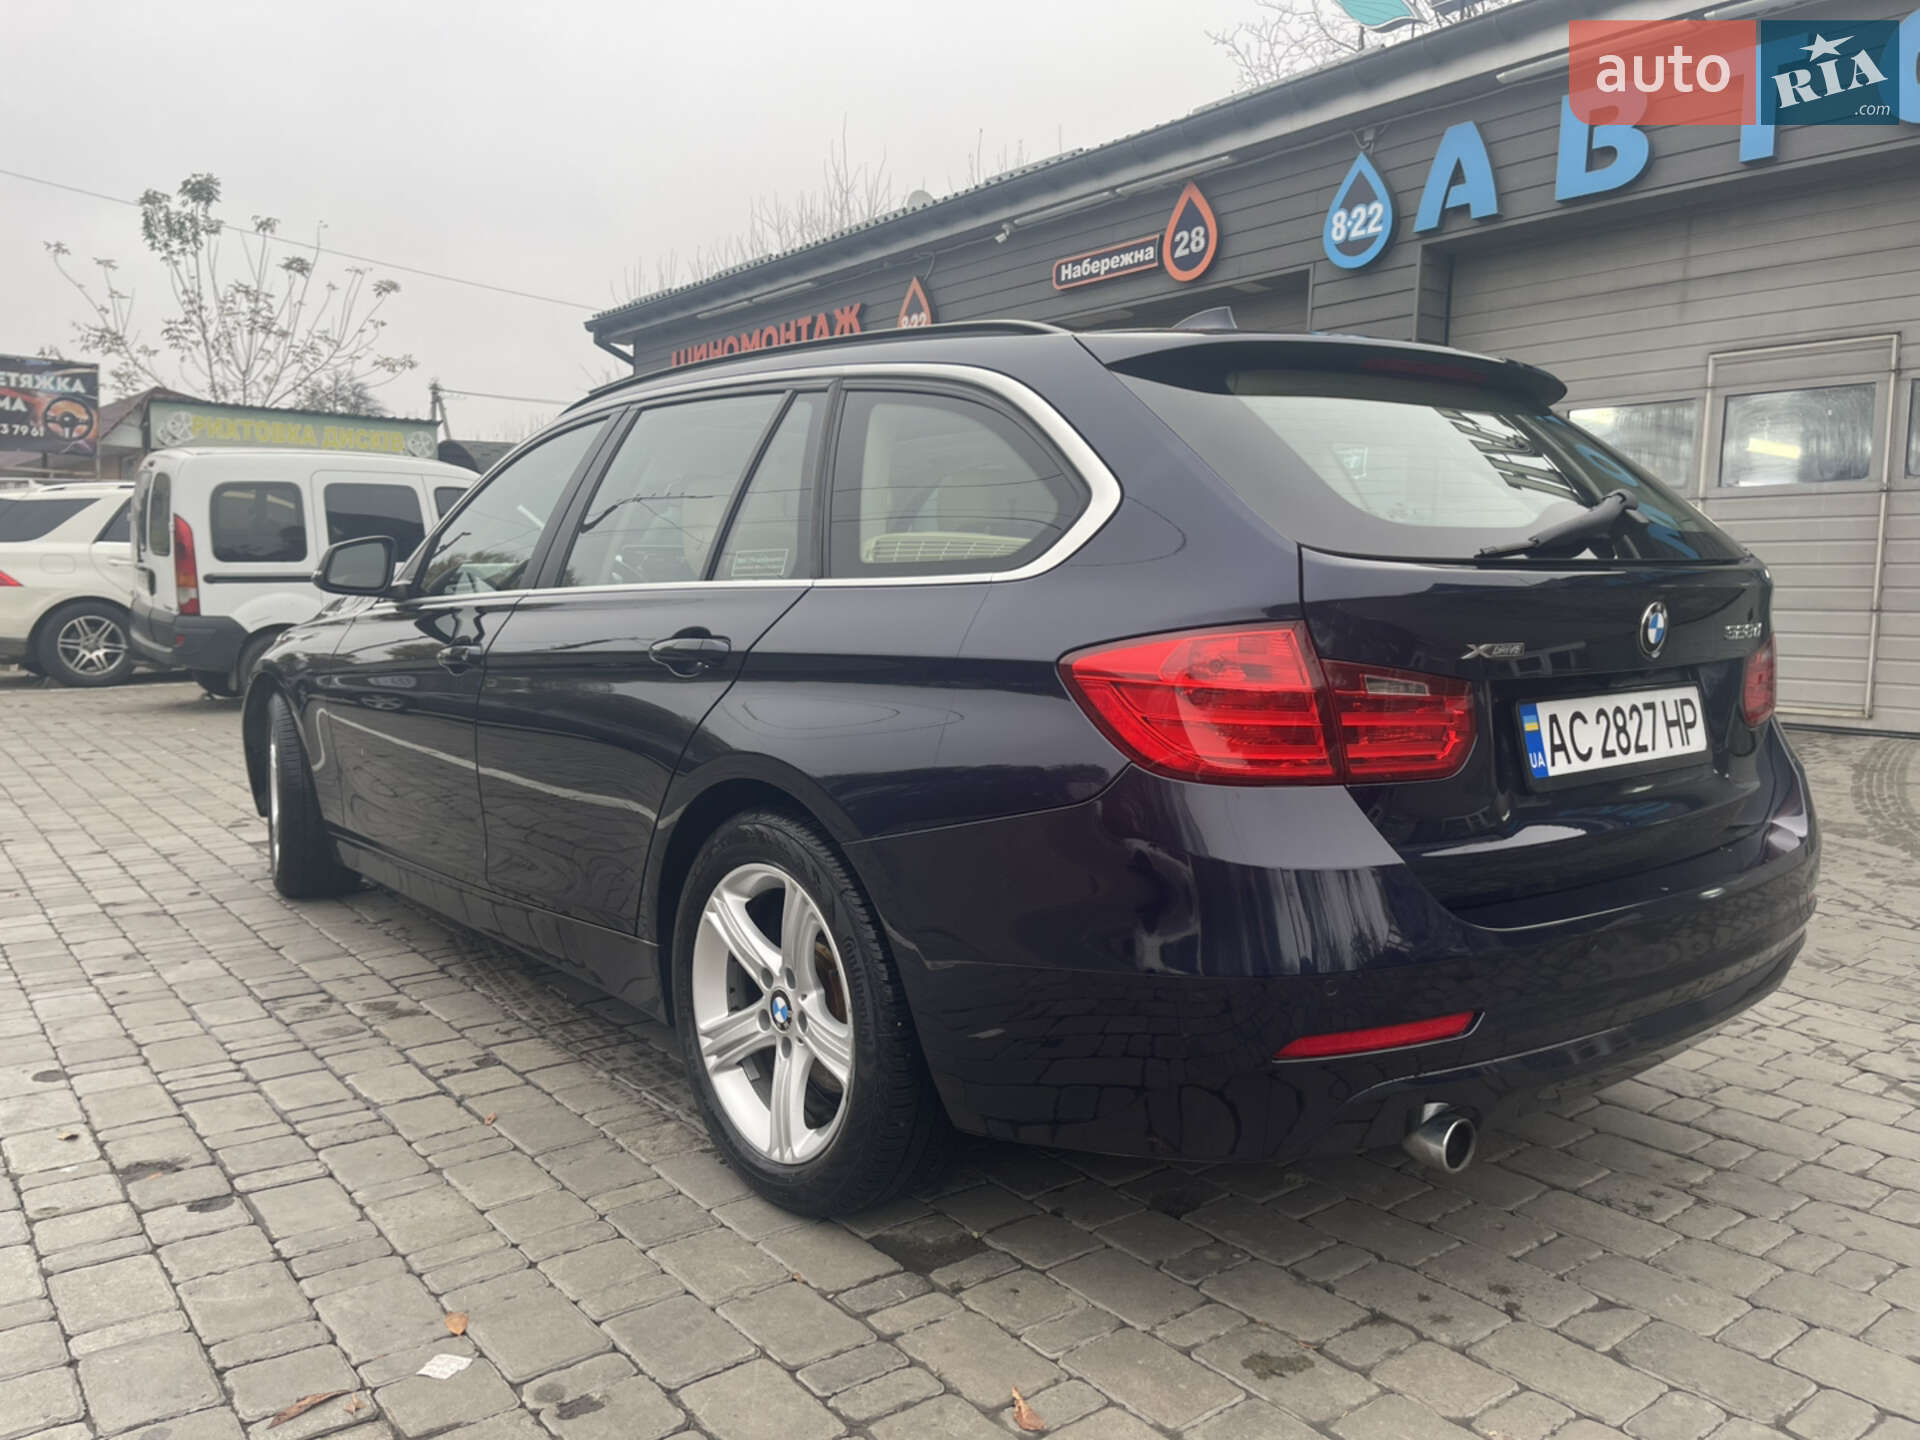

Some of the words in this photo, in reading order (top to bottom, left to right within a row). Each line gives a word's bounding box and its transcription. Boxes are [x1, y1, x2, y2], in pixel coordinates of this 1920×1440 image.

[1060, 245, 1155, 282] Набережна
[1174, 226, 1206, 259] 28
[191, 415, 316, 448] РИХТОВКА
[321, 425, 406, 452] ДИСКІВ
[1548, 711, 1593, 767] AC
[1596, 702, 1657, 760] 2827
[1662, 697, 1698, 749] HP
[1529, 752, 1546, 769] UA
